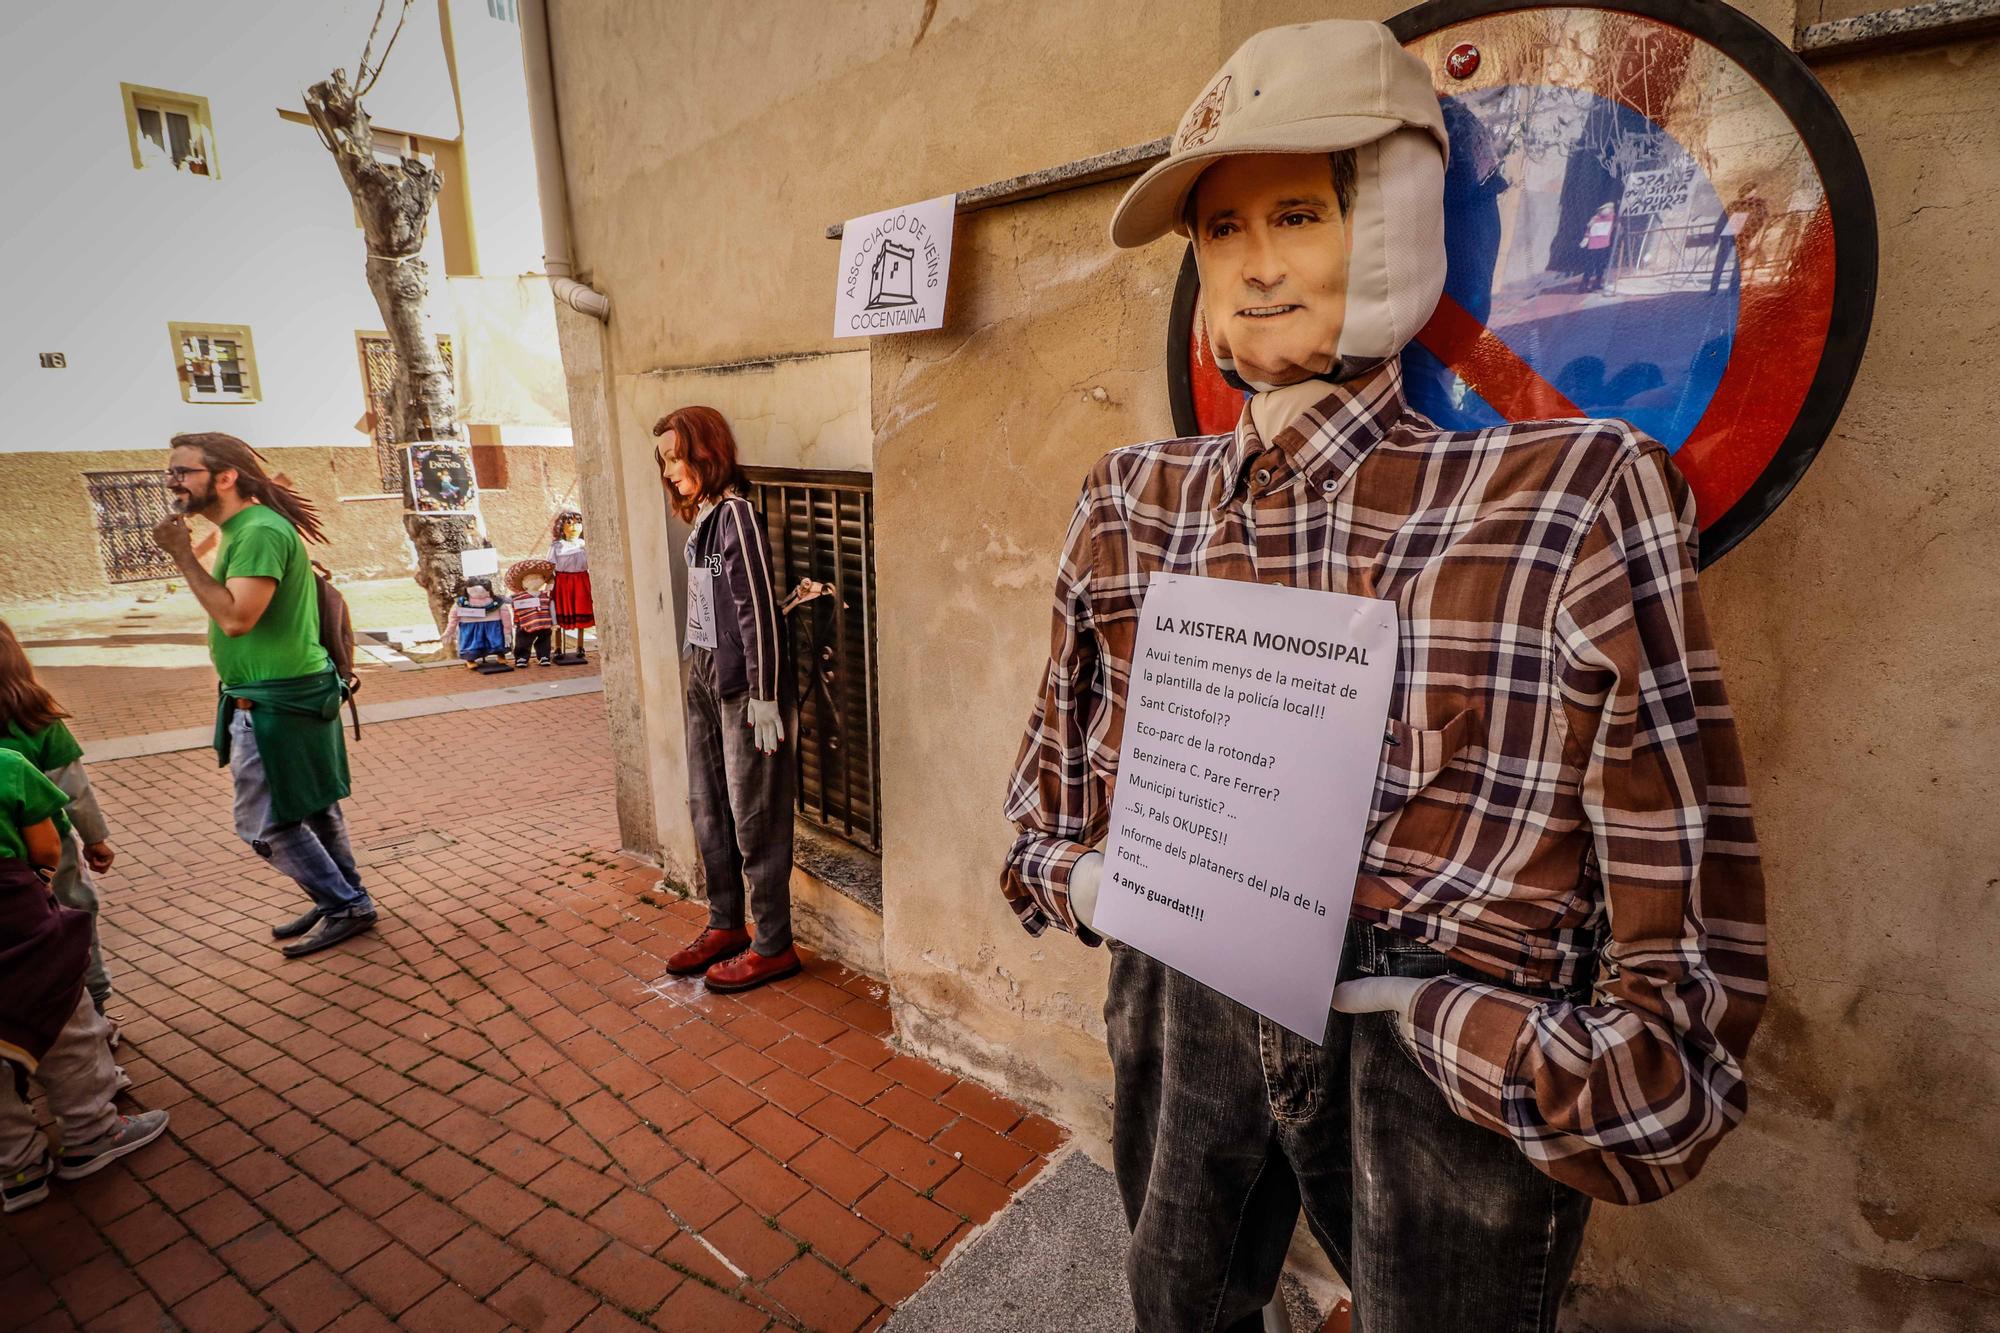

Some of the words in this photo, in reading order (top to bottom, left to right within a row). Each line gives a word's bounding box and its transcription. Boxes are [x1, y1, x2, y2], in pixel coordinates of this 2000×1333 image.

[846, 210, 906, 298] ASSOCIACIÓ
[908, 217, 926, 240] DE
[924, 236, 940, 288] VEÏNS
[850, 308, 926, 330] COCENTAINA
[40, 353, 65, 367] 16
[1156, 616, 1174, 633] LA
[1180, 619, 1248, 645] XISTERA
[1253, 631, 1370, 666] MONOSIPAL
[1143, 669, 1152, 682] la
[1155, 672, 1202, 692] plantilla
[1205, 682, 1220, 696] de
[1224, 686, 1234, 699] la
[1238, 691, 1279, 710] policía
[1283, 698, 1326, 720] local!!
[1146, 648, 1170, 662] Avui
[1174, 652, 1208, 670] tenim
[1212, 661, 1252, 679] menys
[1256, 668, 1272, 682] de
[1276, 670, 1287, 686] la
[1290, 674, 1336, 696] meitat
[1339, 684, 1358, 699] de
[1140, 696, 1164, 712] Sant
[1168, 702, 1230, 728] Cristofol??
[1136, 722, 1184, 745] Eco-parc
[1187, 735, 1202, 750] de
[1204, 738, 1215, 752] la
[1218, 743, 1276, 770] rotonda?
[1129, 774, 1176, 798] Municipi
[1178, 788, 1225, 814] turistic?
[1132, 748, 1186, 774] Benzinera
[1190, 764, 1200, 778] C.
[1204, 768, 1230, 786] Pare
[1234, 778, 1280, 802] Ferrer?
[1148, 806, 1170, 824] Pals
[1172, 816, 1228, 846] OKUPES!!
[1117, 846, 1149, 869] Font...
[1121, 824, 1162, 850] Informe
[1164, 842, 1186, 860] dels
[1189, 853, 1244, 884] plataners
[1247, 875, 1267, 892] del
[1270, 884, 1290, 902] pla
[1294, 893, 1310, 910] de
[1314, 900, 1326, 916] la
[1112, 872, 1120, 883] 4
[1122, 878, 1145, 895] anys
[1146, 889, 1206, 922] guardat!!!
